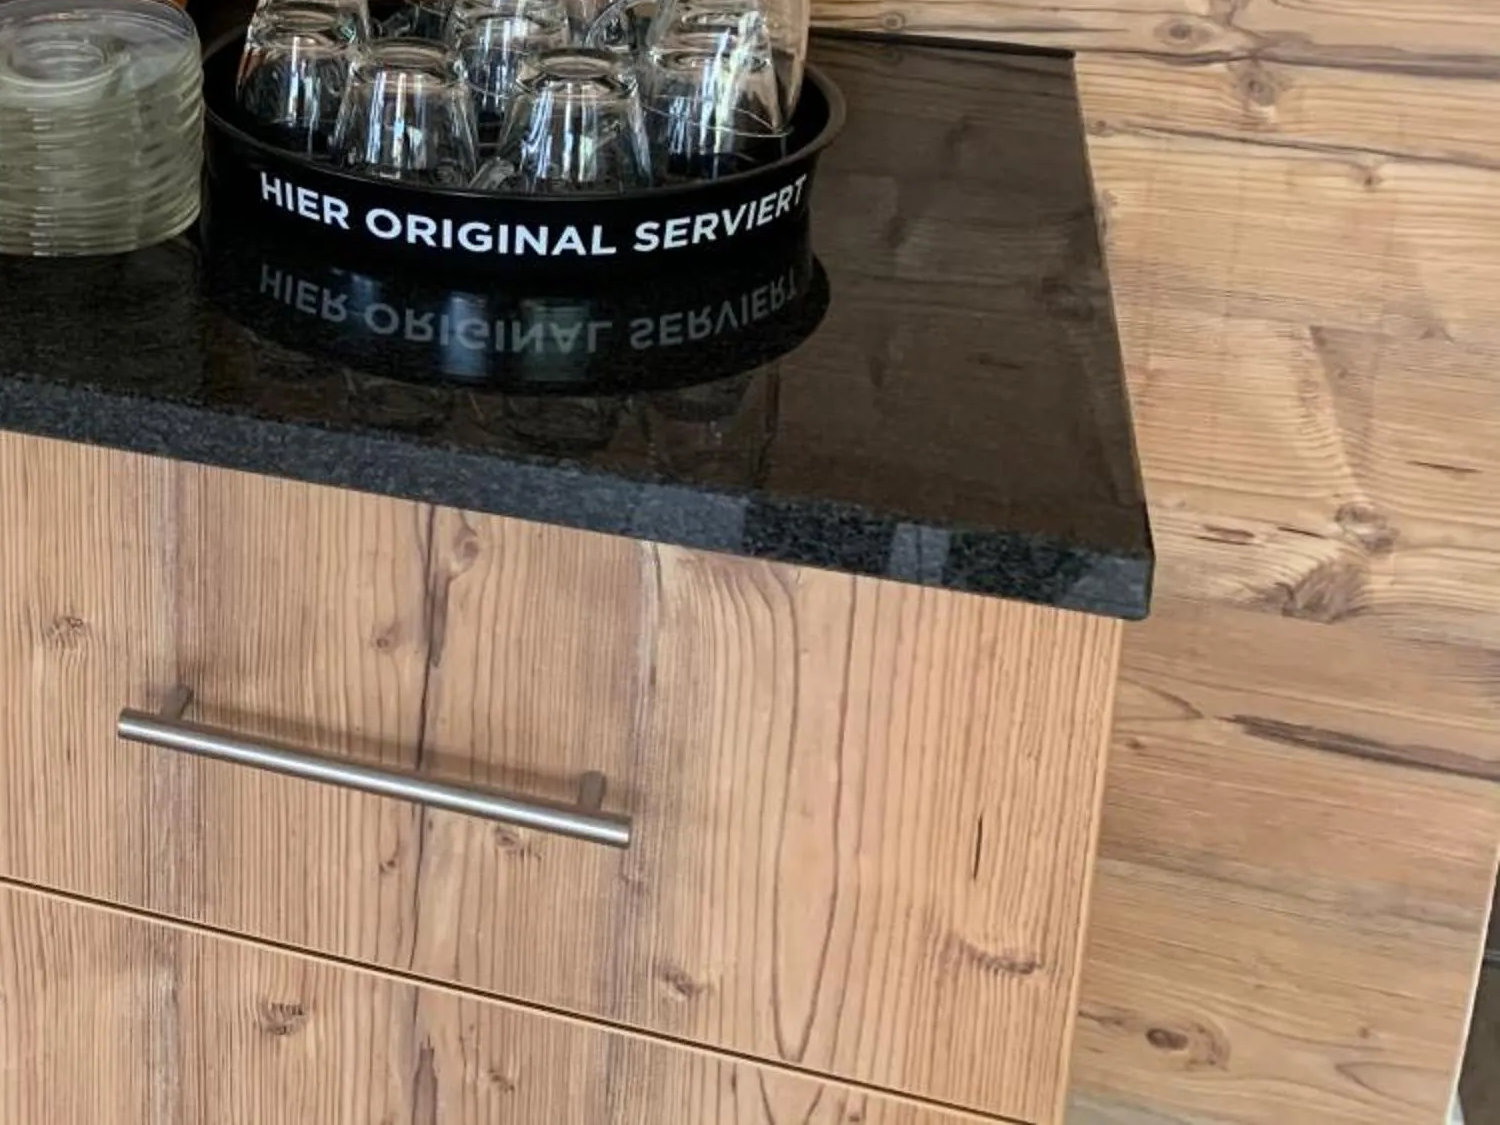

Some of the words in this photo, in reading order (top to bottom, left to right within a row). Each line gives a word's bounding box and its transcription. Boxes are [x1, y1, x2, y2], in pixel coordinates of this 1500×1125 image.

[261, 171, 350, 230] HIER
[365, 207, 618, 257] ORIGINAL
[632, 173, 808, 253] SERVIERT
